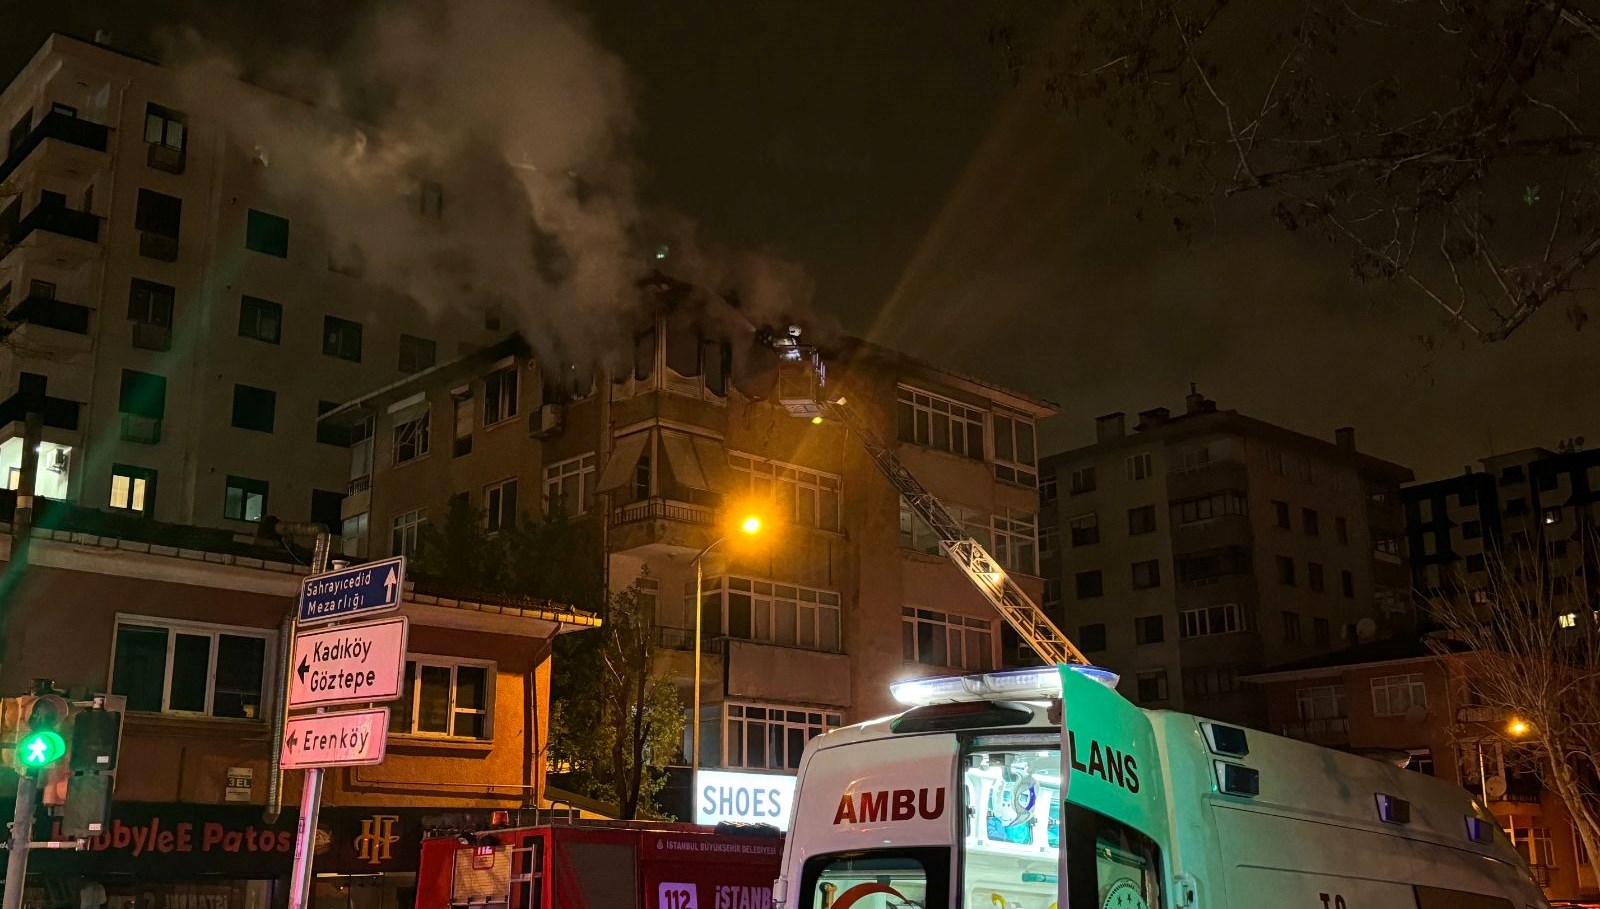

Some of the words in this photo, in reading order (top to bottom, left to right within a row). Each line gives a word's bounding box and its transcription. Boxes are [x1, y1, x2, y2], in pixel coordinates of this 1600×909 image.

[306, 570, 371, 597] Sahrayıcedid
[307, 594, 365, 616] Mezarlığı
[313, 638, 373, 663] Kadıköy
[310, 669, 376, 693] Göztepe
[303, 728, 369, 754] Erenköy
[1069, 731, 1140, 794] LANS
[702, 786, 782, 817] SHOES
[833, 787, 946, 825] AMBU
[202, 821, 291, 853] Patos
[665, 890, 691, 909] 112
